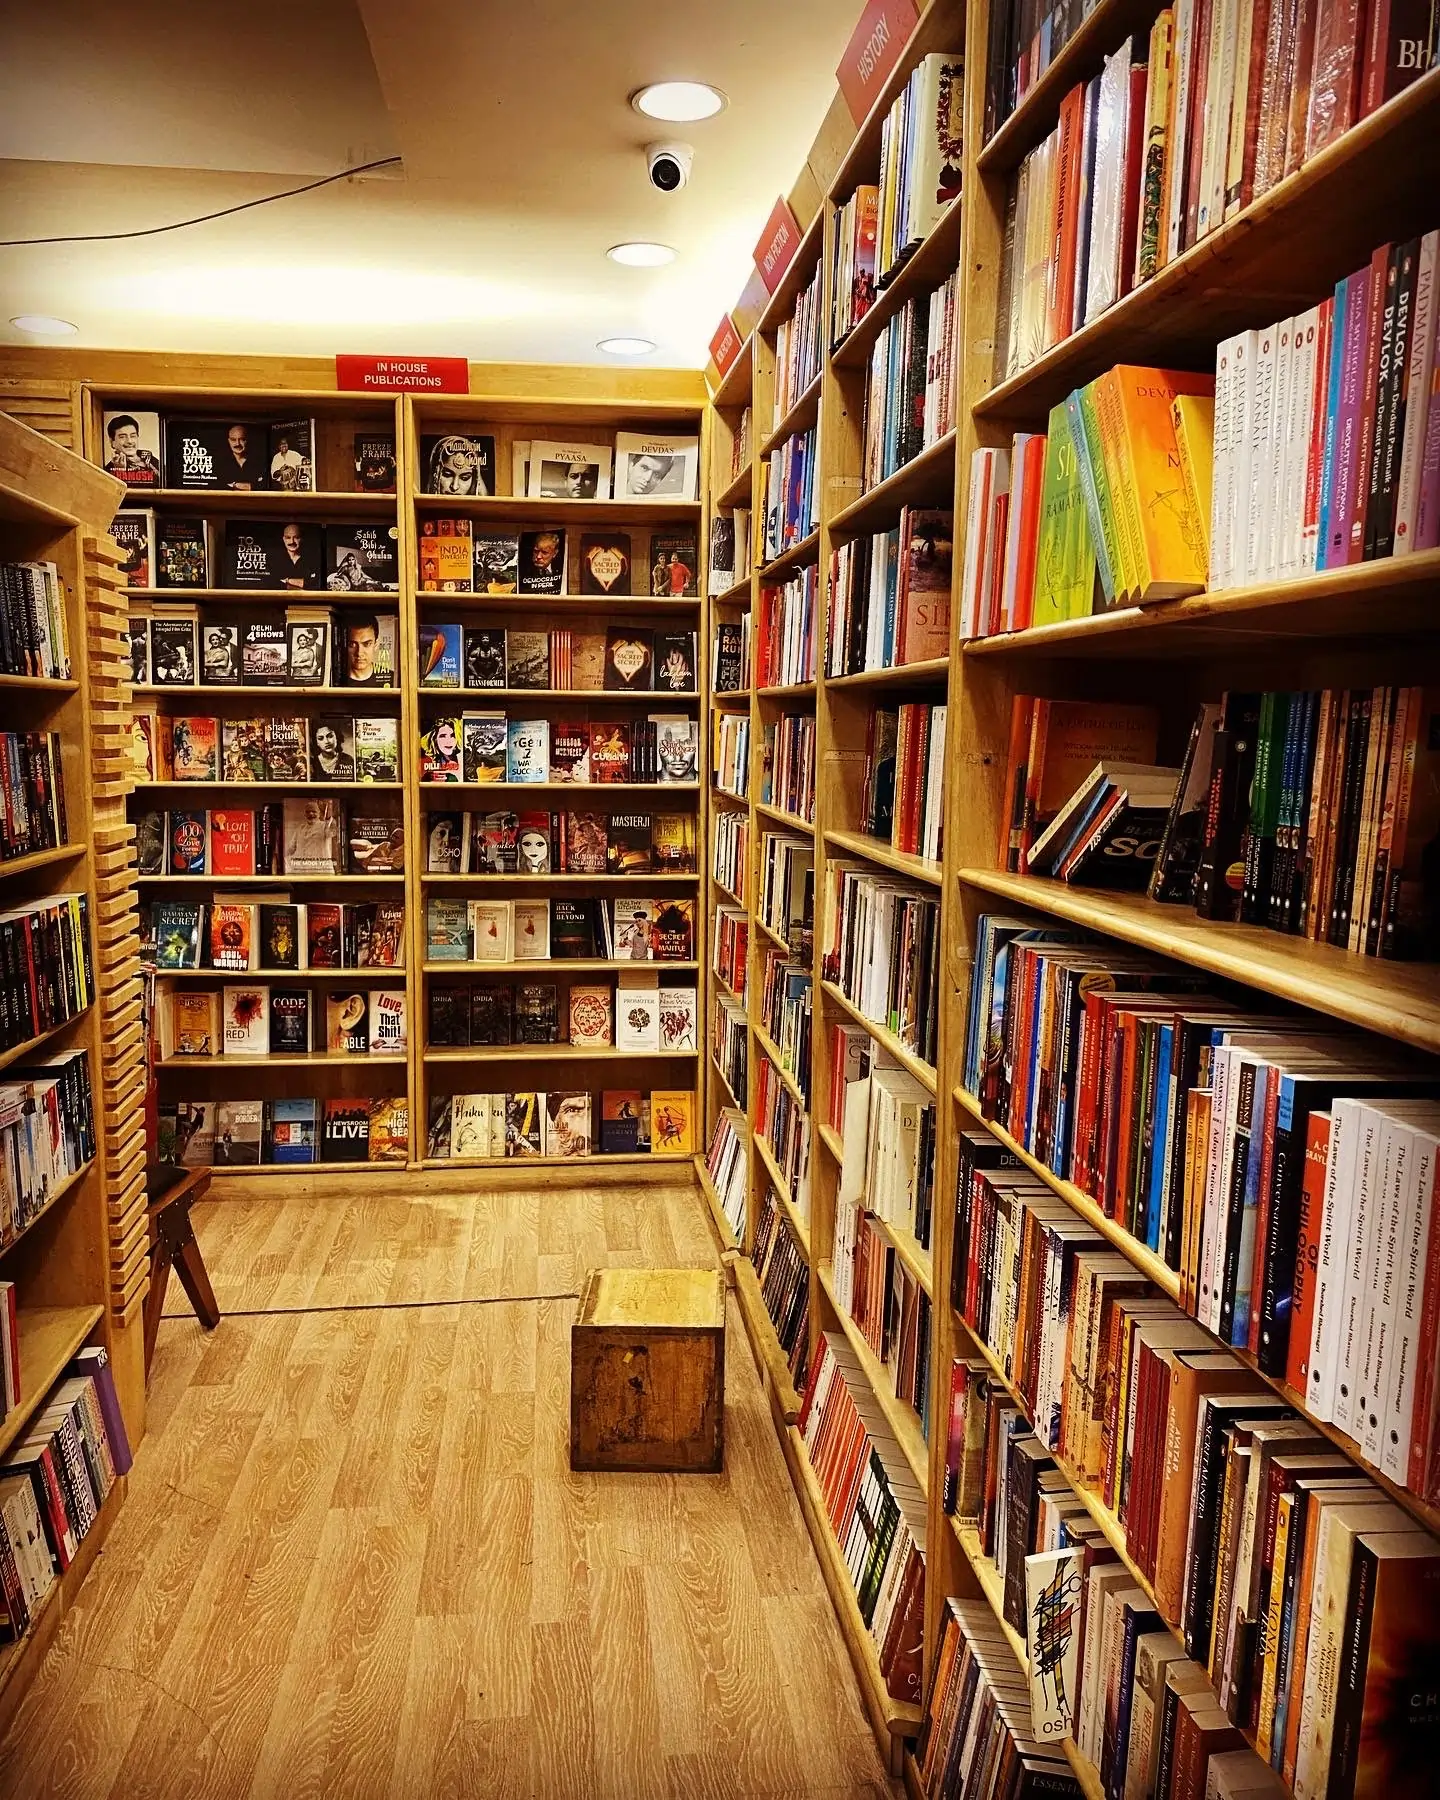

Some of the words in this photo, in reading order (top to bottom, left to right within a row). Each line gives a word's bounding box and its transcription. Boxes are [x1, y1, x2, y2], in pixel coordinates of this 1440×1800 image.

[857, 17, 890, 84] HISTORY
[1392, 292, 1410, 370] DEVLOK
[1379, 307, 1395, 382] DEVLOK
[364, 375, 441, 386] PUBLICATIONS
[377, 363, 387, 372] IN
[390, 363, 428, 373] HOUSE
[1375, 406, 1384, 446] Devdutt
[1388, 393, 1399, 434] Devdutt
[183, 439, 199, 447] TO
[183, 448, 207, 456] DAD
[641, 445, 674, 454] DEVDAS
[1343, 418, 1352, 464] DEVDUTT
[183, 456, 212, 464] WITH
[183, 465, 212, 473] LOVE
[1371, 449, 1380, 494] Pattanaik
[1384, 438, 1395, 483] Pattanaik
[238, 553, 266, 561] WITH
[440, 546, 468, 555] INDIA
[238, 561, 266, 569] LOVE
[612, 816, 649, 826] MASTERJI
[378, 994, 403, 1015] Love,
[226, 1030, 245, 1038] RED
[379, 1026, 400, 1037] Shit!
[1334, 1116, 1342, 1137] The
[1365, 1128, 1374, 1148] The
[1211, 1129, 1219, 1159] Adopt
[1331, 1140, 1339, 1166] Laws
[1398, 1146, 1406, 1166] The
[1328, 1168, 1338, 1181] of
[1362, 1151, 1371, 1179] Laws
[1420, 1156, 1429, 1177] The
[1328, 1182, 1336, 1199] the
[1360, 1180, 1369, 1192] of
[1394, 1170, 1403, 1198] Laws
[1416, 1181, 1426, 1210] Laws
[1269, 1152, 1287, 1257] Conversations
[1359, 1193, 1368, 1210] the
[1391, 1200, 1400, 1215] of
[1324, 1200, 1334, 1232] Spirit
[1354, 1212, 1366, 1244] Spirit
[1390, 1216, 1399, 1233] the
[1414, 1213, 1422, 1226] of
[1412, 1228, 1420, 1244] the
[1307, 1244, 1319, 1274] OF
[1322, 1234, 1332, 1266] World
[1386, 1236, 1397, 1266] Spirit
[1352, 1247, 1363, 1280] World
[1408, 1248, 1419, 1280] Spirit
[1382, 1270, 1393, 1305] World
[1263, 1289, 1274, 1321] God
[1404, 1284, 1415, 1319] World
[1203, 1423, 1213, 1464] SECRET
[1198, 1466, 1209, 1519] MANTRA
[1266, 1596, 1281, 1662] MONK
